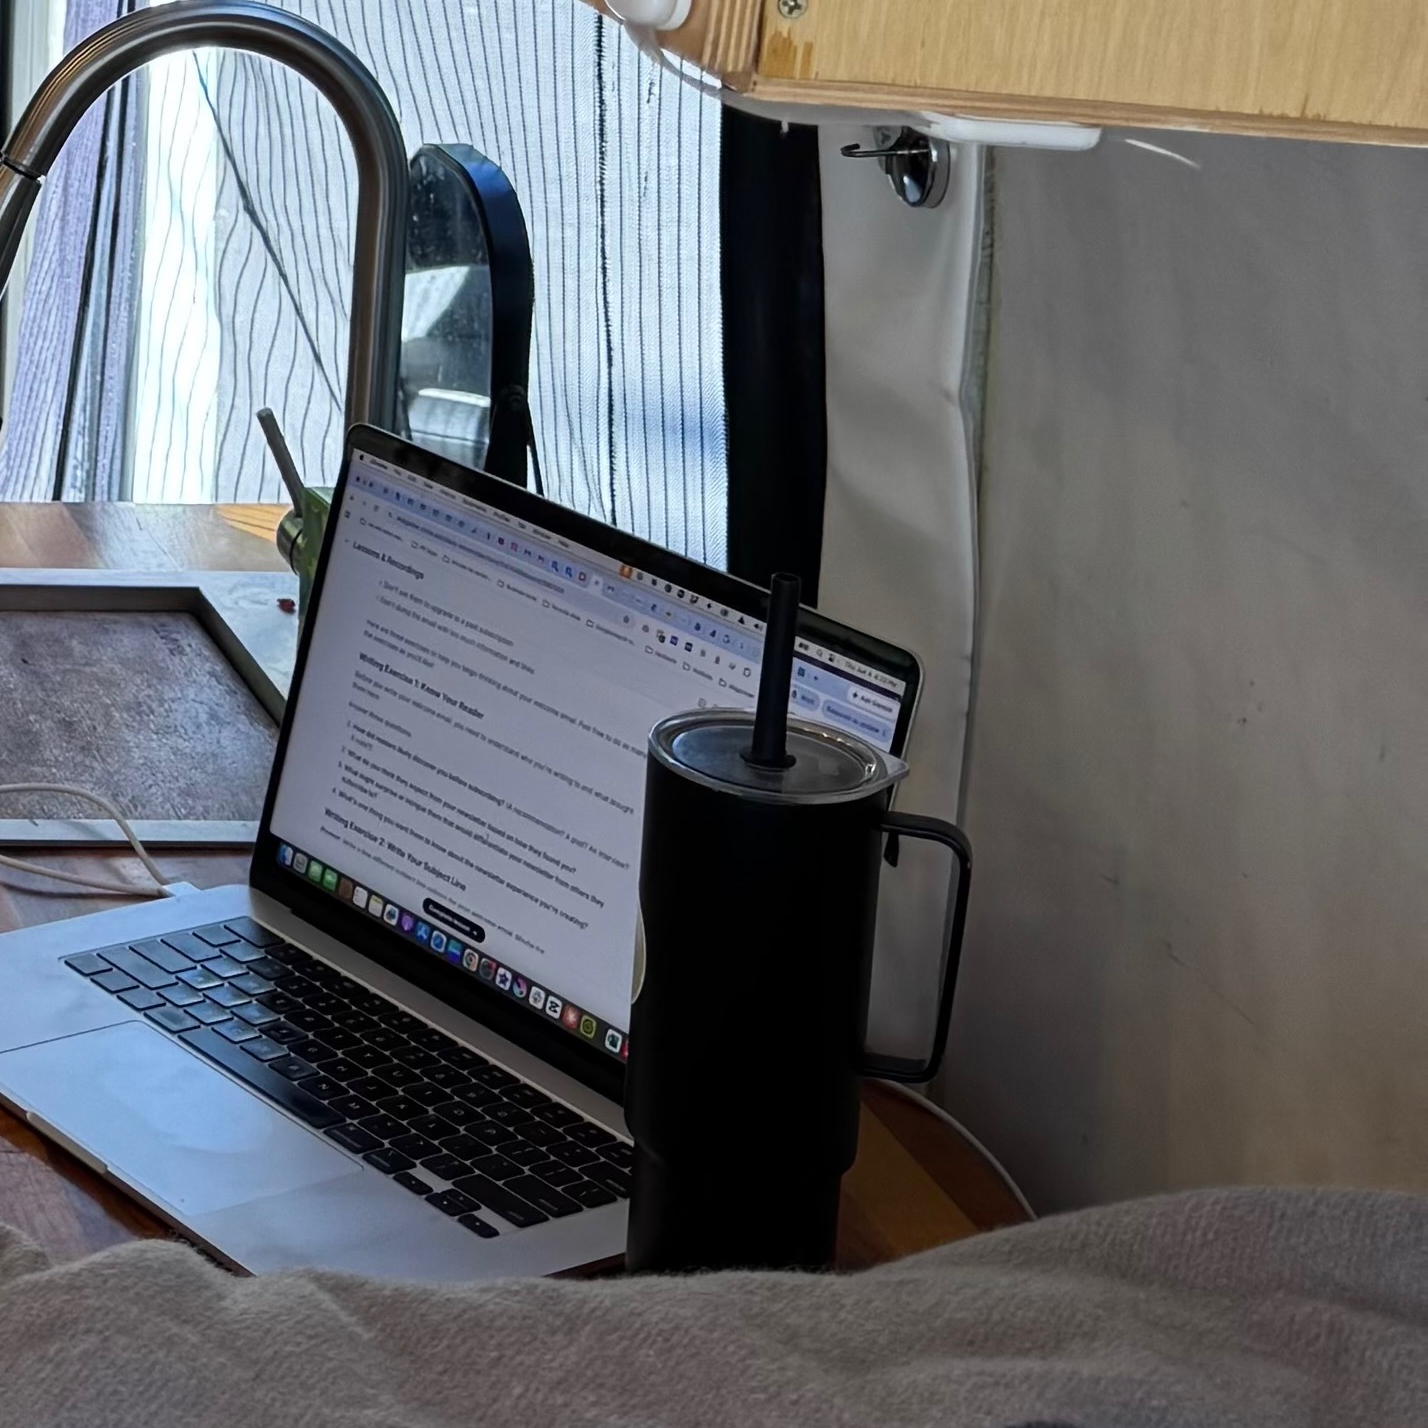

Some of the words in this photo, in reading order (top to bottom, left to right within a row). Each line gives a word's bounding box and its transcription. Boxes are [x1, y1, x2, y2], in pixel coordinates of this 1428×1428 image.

[406, 853, 422, 868] Your
[423, 860, 450, 885] Subject
[451, 876, 466, 891] Line
